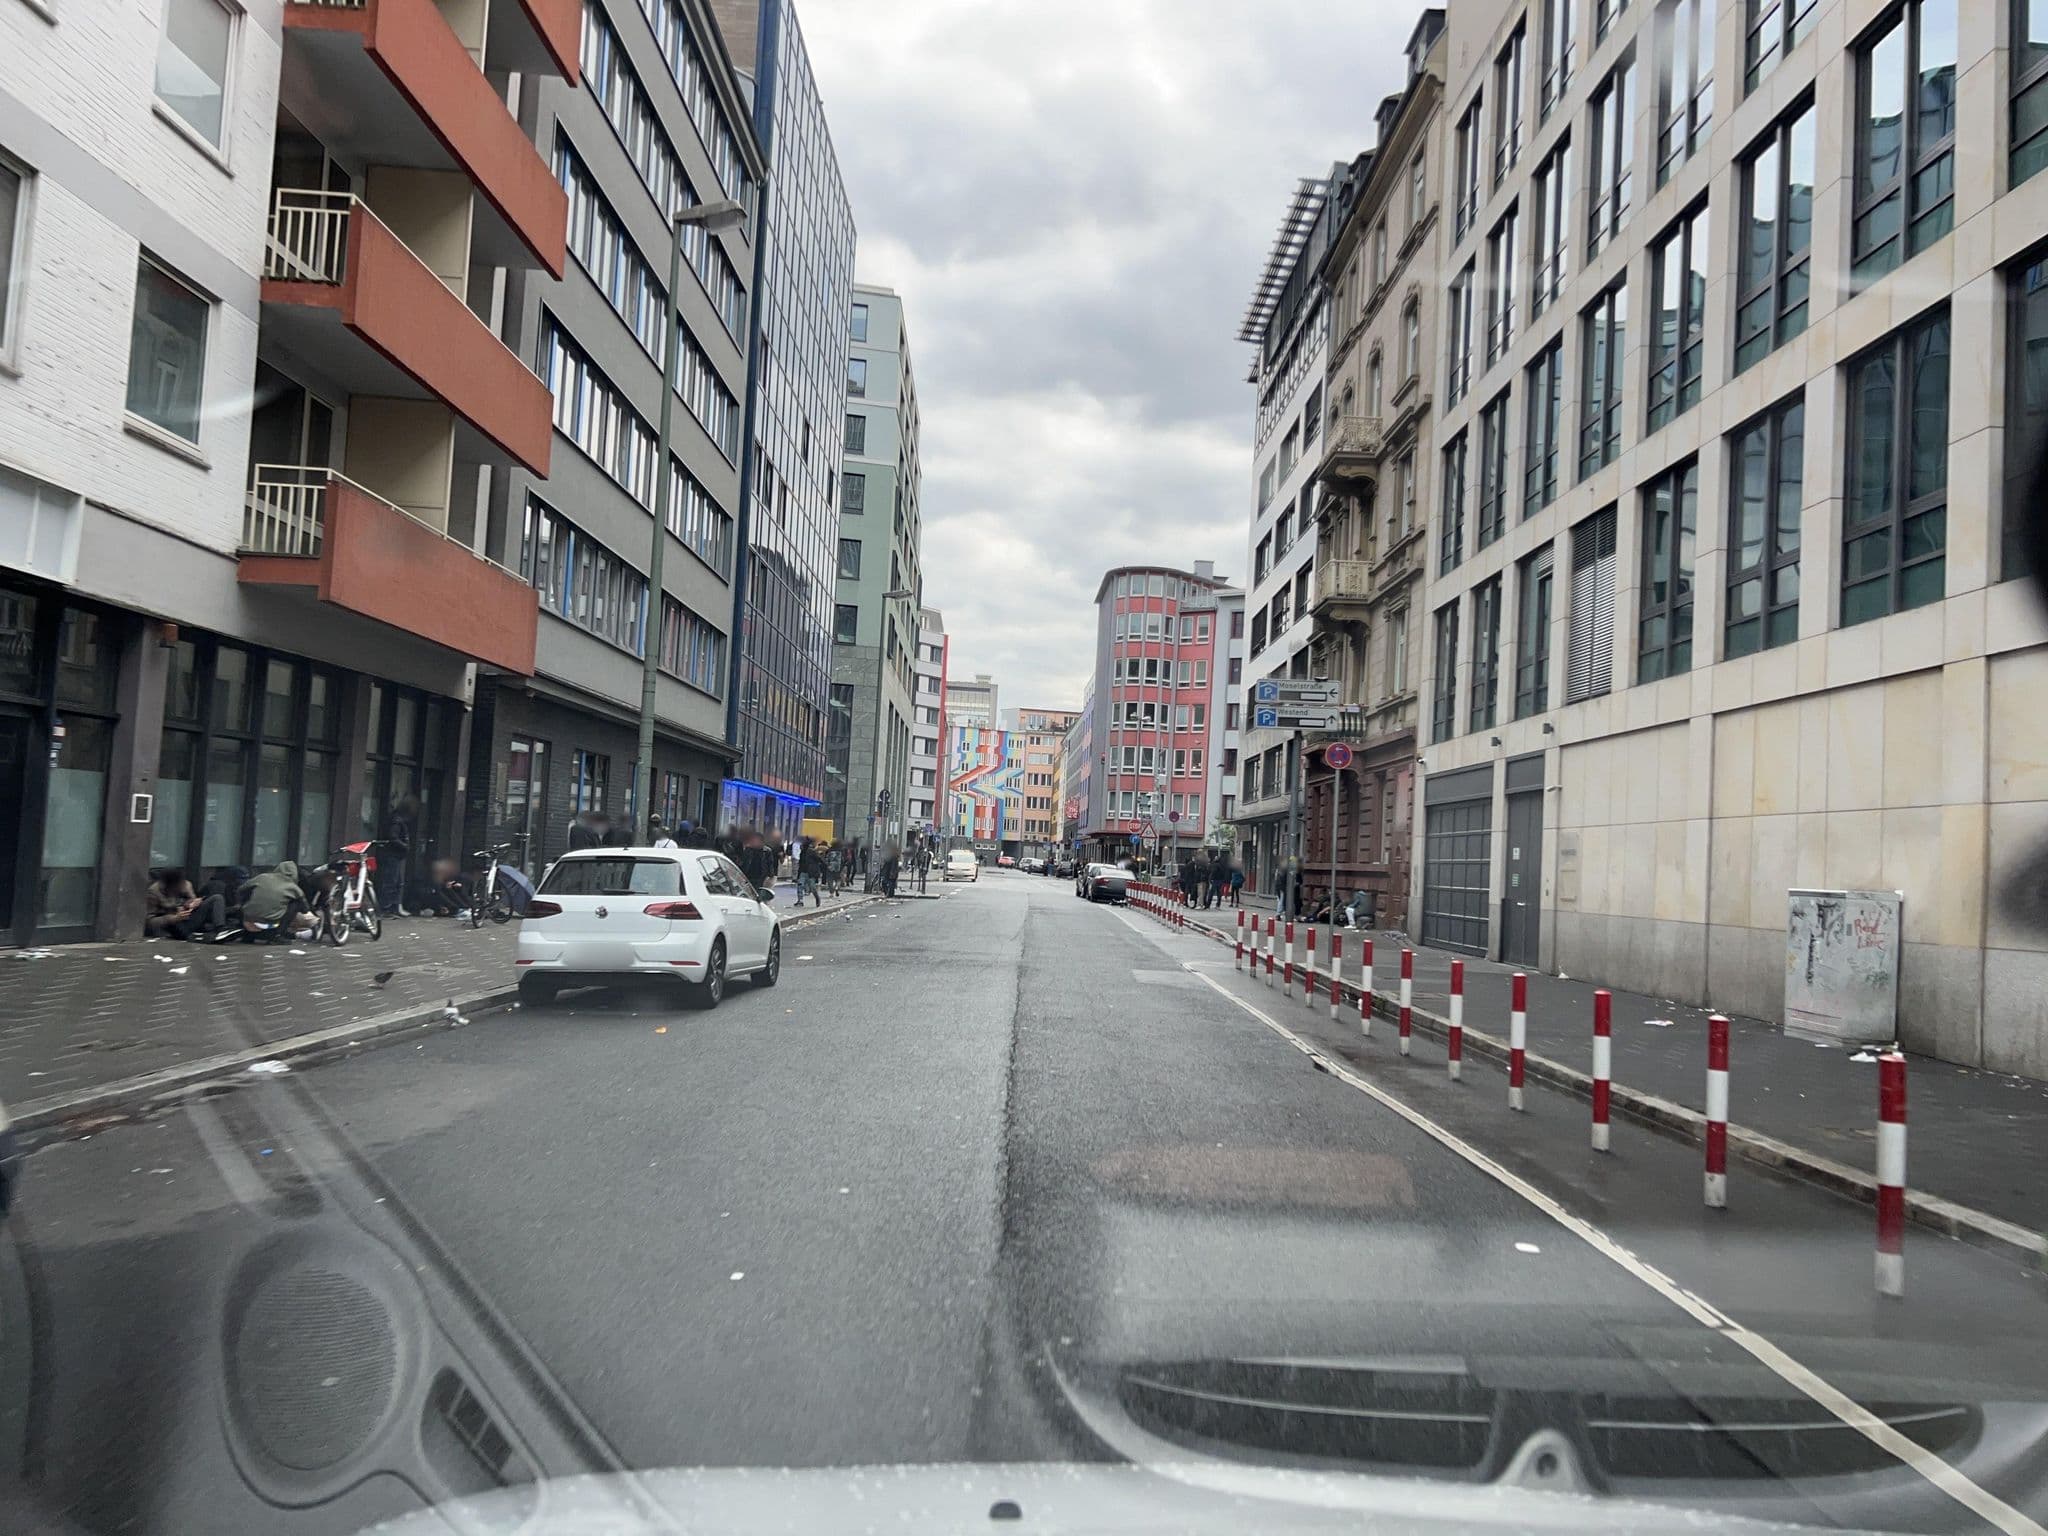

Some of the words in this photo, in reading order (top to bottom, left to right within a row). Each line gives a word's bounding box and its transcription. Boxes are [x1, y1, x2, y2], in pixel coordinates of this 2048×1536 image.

[1264, 686, 1272, 697] P
[1279, 682, 1324, 690] Moselstraße
[1263, 713, 1271, 724] P
